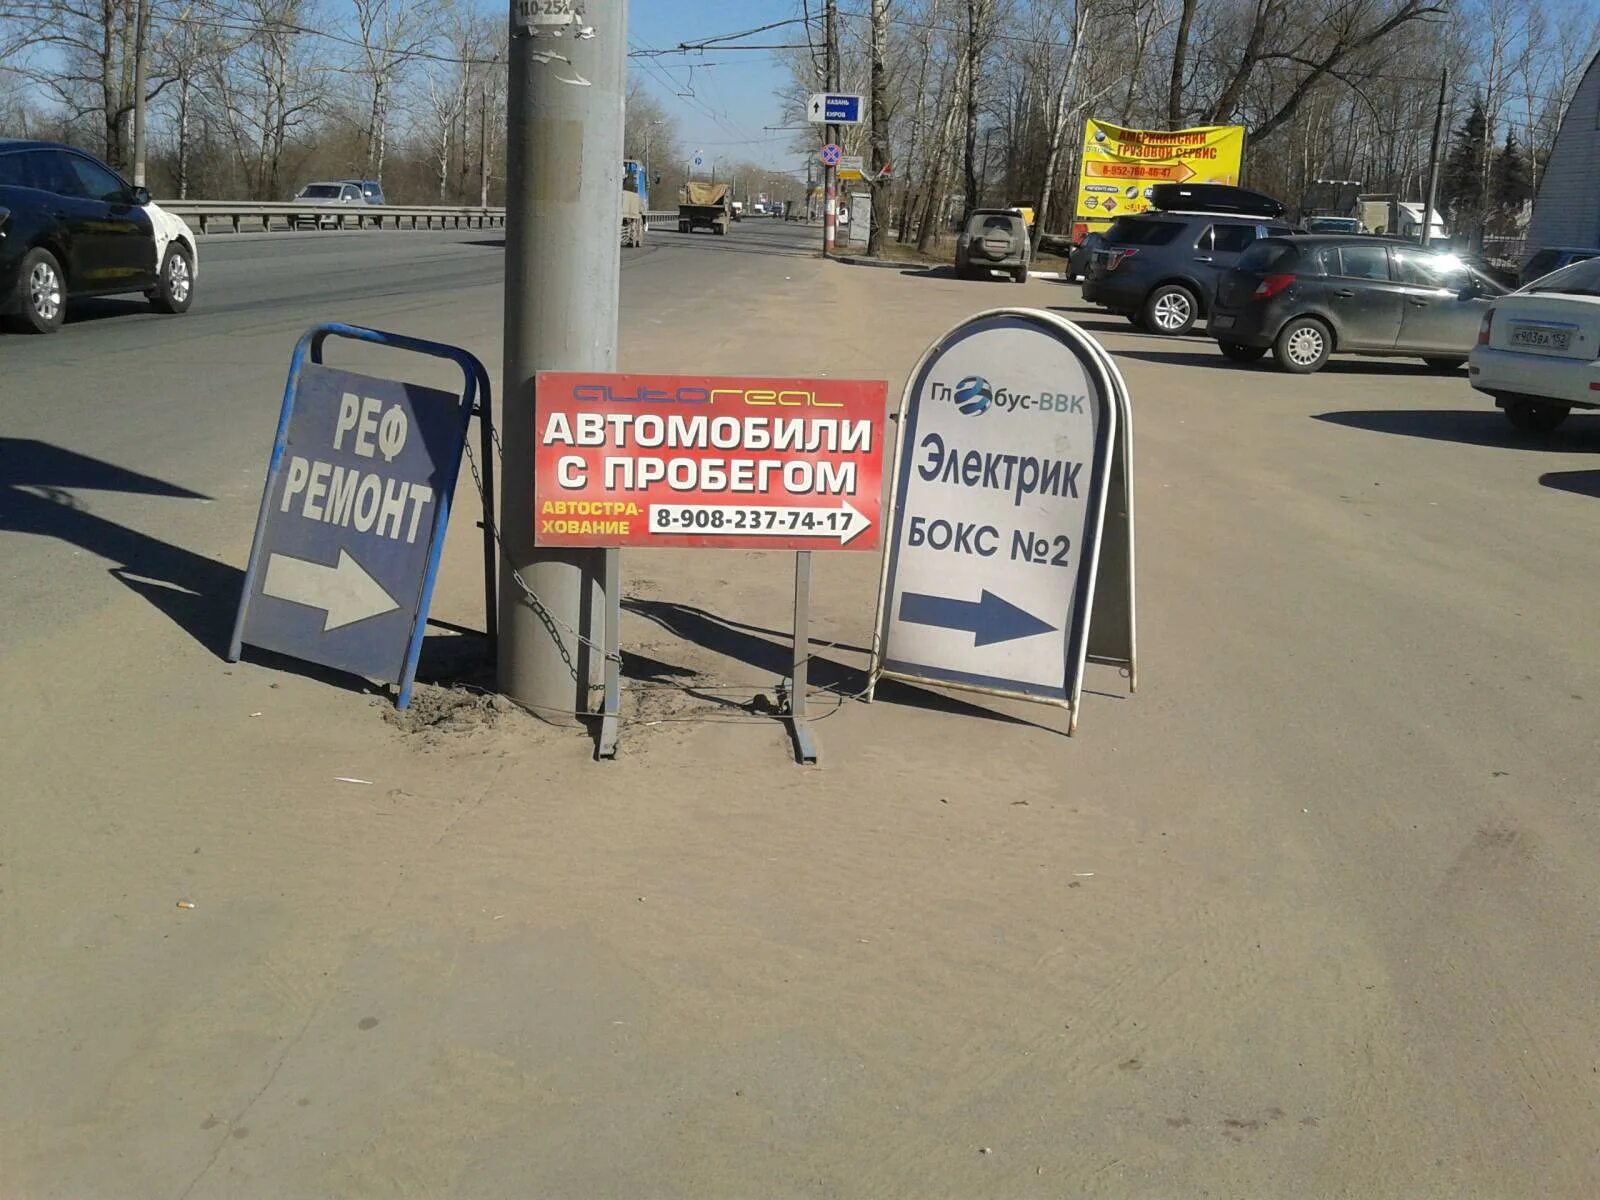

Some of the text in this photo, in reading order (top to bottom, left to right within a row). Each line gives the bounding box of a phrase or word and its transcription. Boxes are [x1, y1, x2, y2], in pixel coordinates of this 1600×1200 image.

[1117, 145, 1173, 160] ГРУЗОВОЙ
[1175, 147, 1217, 160] СЕРВИС
[333, 392, 408, 463] РЕФ
[542, 412, 873, 453] АВТОМОБИЛИ
[556, 455, 857, 495] С ПРОБЕГОМ
[918, 433, 1083, 506] Электрик
[280, 456, 433, 543] РЕМОНТ
[542, 500, 644, 517] АВТОСТРА-
[542, 520, 631, 535] ХОВАНИЕ
[656, 508, 853, 532] 8-908-237-74-17
[908, 516, 1071, 567] БОКС №2
